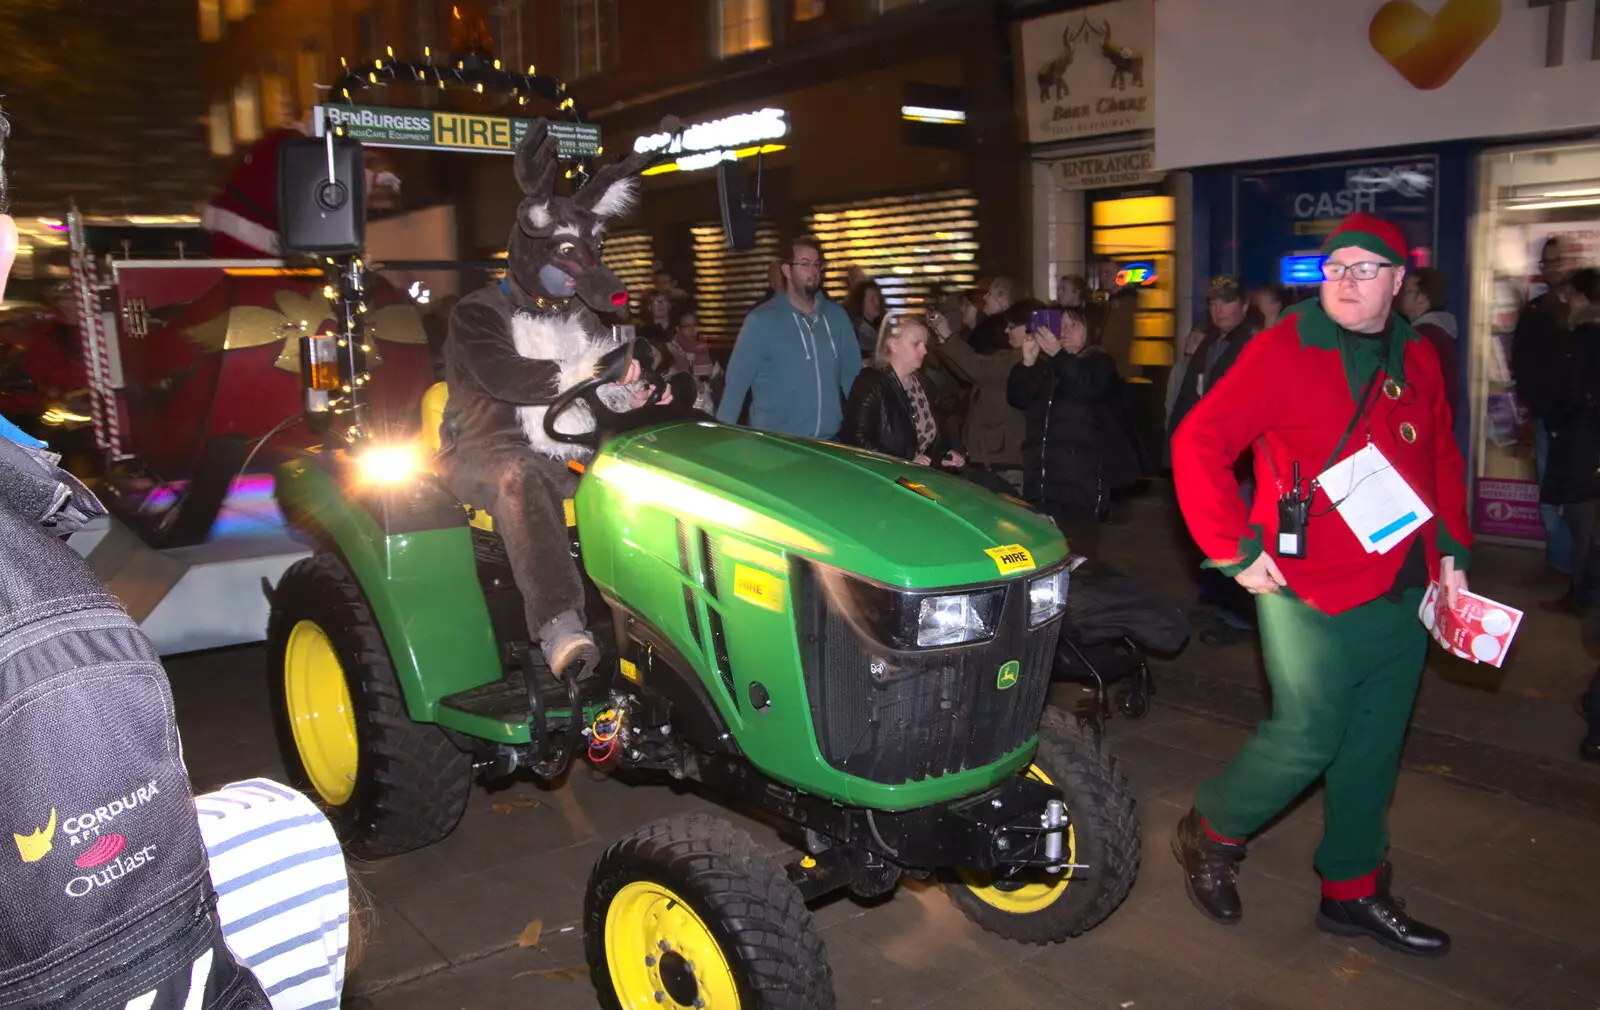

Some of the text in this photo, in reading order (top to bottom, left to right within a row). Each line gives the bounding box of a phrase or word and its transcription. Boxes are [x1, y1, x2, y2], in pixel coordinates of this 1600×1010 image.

[437, 116, 509, 147] HIRE
[1060, 153, 1153, 178] ENTRANCE
[1294, 188, 1375, 218] CASH
[1000, 551, 1028, 564] HIRE
[62, 781, 161, 835] CORDURA
[64, 846, 155, 897] Outlast
